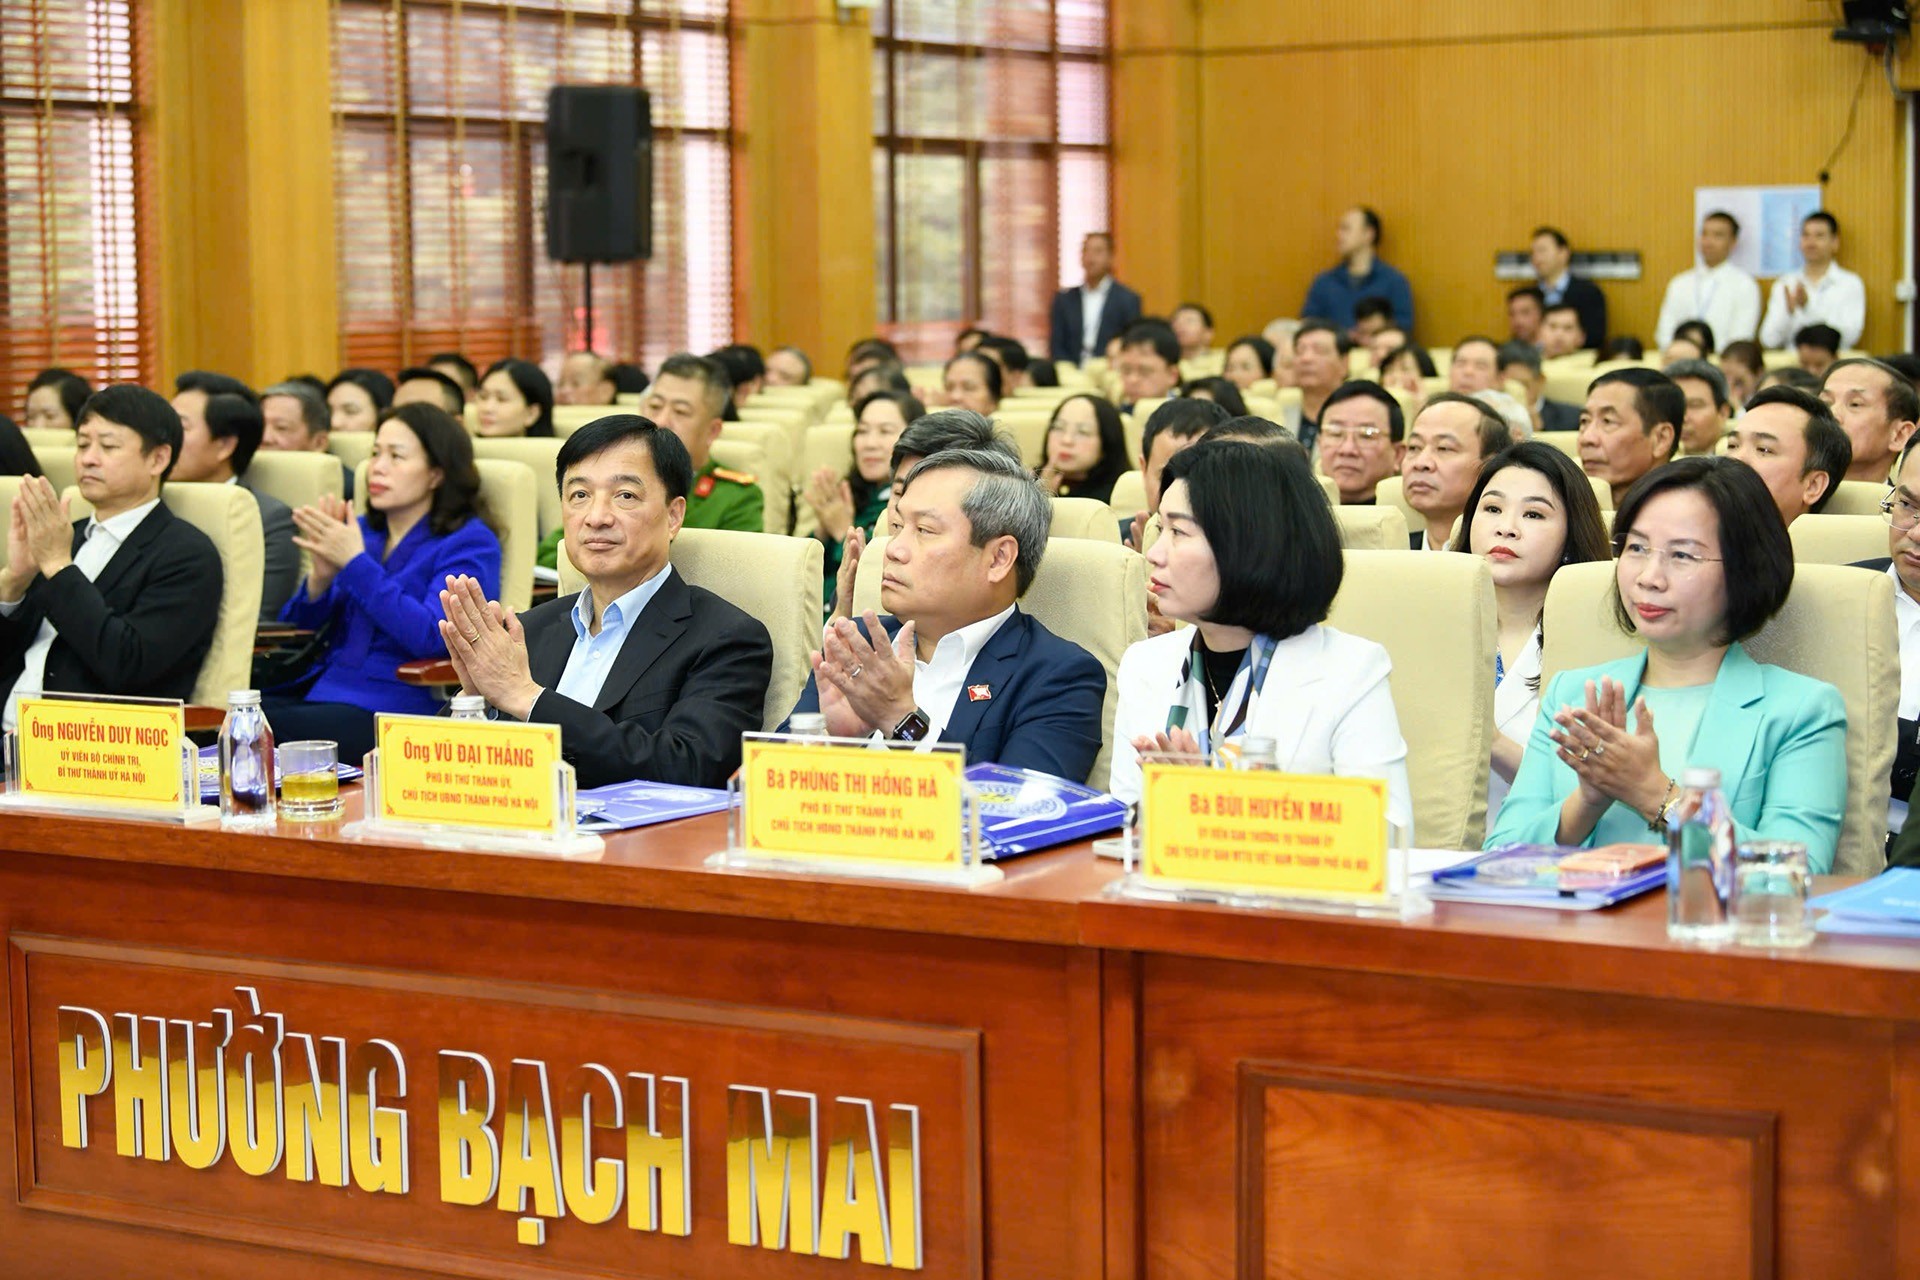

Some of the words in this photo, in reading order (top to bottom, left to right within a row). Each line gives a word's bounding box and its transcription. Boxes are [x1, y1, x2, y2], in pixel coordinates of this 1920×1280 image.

[32, 716, 54, 741] Ông
[57, 718, 105, 743] NGUYỄN
[108, 725, 131, 744] DUY
[135, 727, 169, 751] NGỌC
[404, 736, 430, 763] Ông
[434, 739, 452, 762] VŨ
[457, 744, 481, 768] ĐẠI
[486, 739, 534, 768] THẮNG
[83, 767, 108, 781] THÀNH
[767, 768, 785, 790] Bà
[790, 768, 840, 793] PHÙNG
[844, 772, 867, 799] THỊ
[918, 775, 938, 799] HÀ
[1190, 793, 1209, 815] Bà
[1309, 800, 1342, 825] MAI
[58, 986, 409, 1194] PHƯỜNG
[437, 1049, 692, 1247] BẠCH
[726, 1083, 922, 1271] MAI
